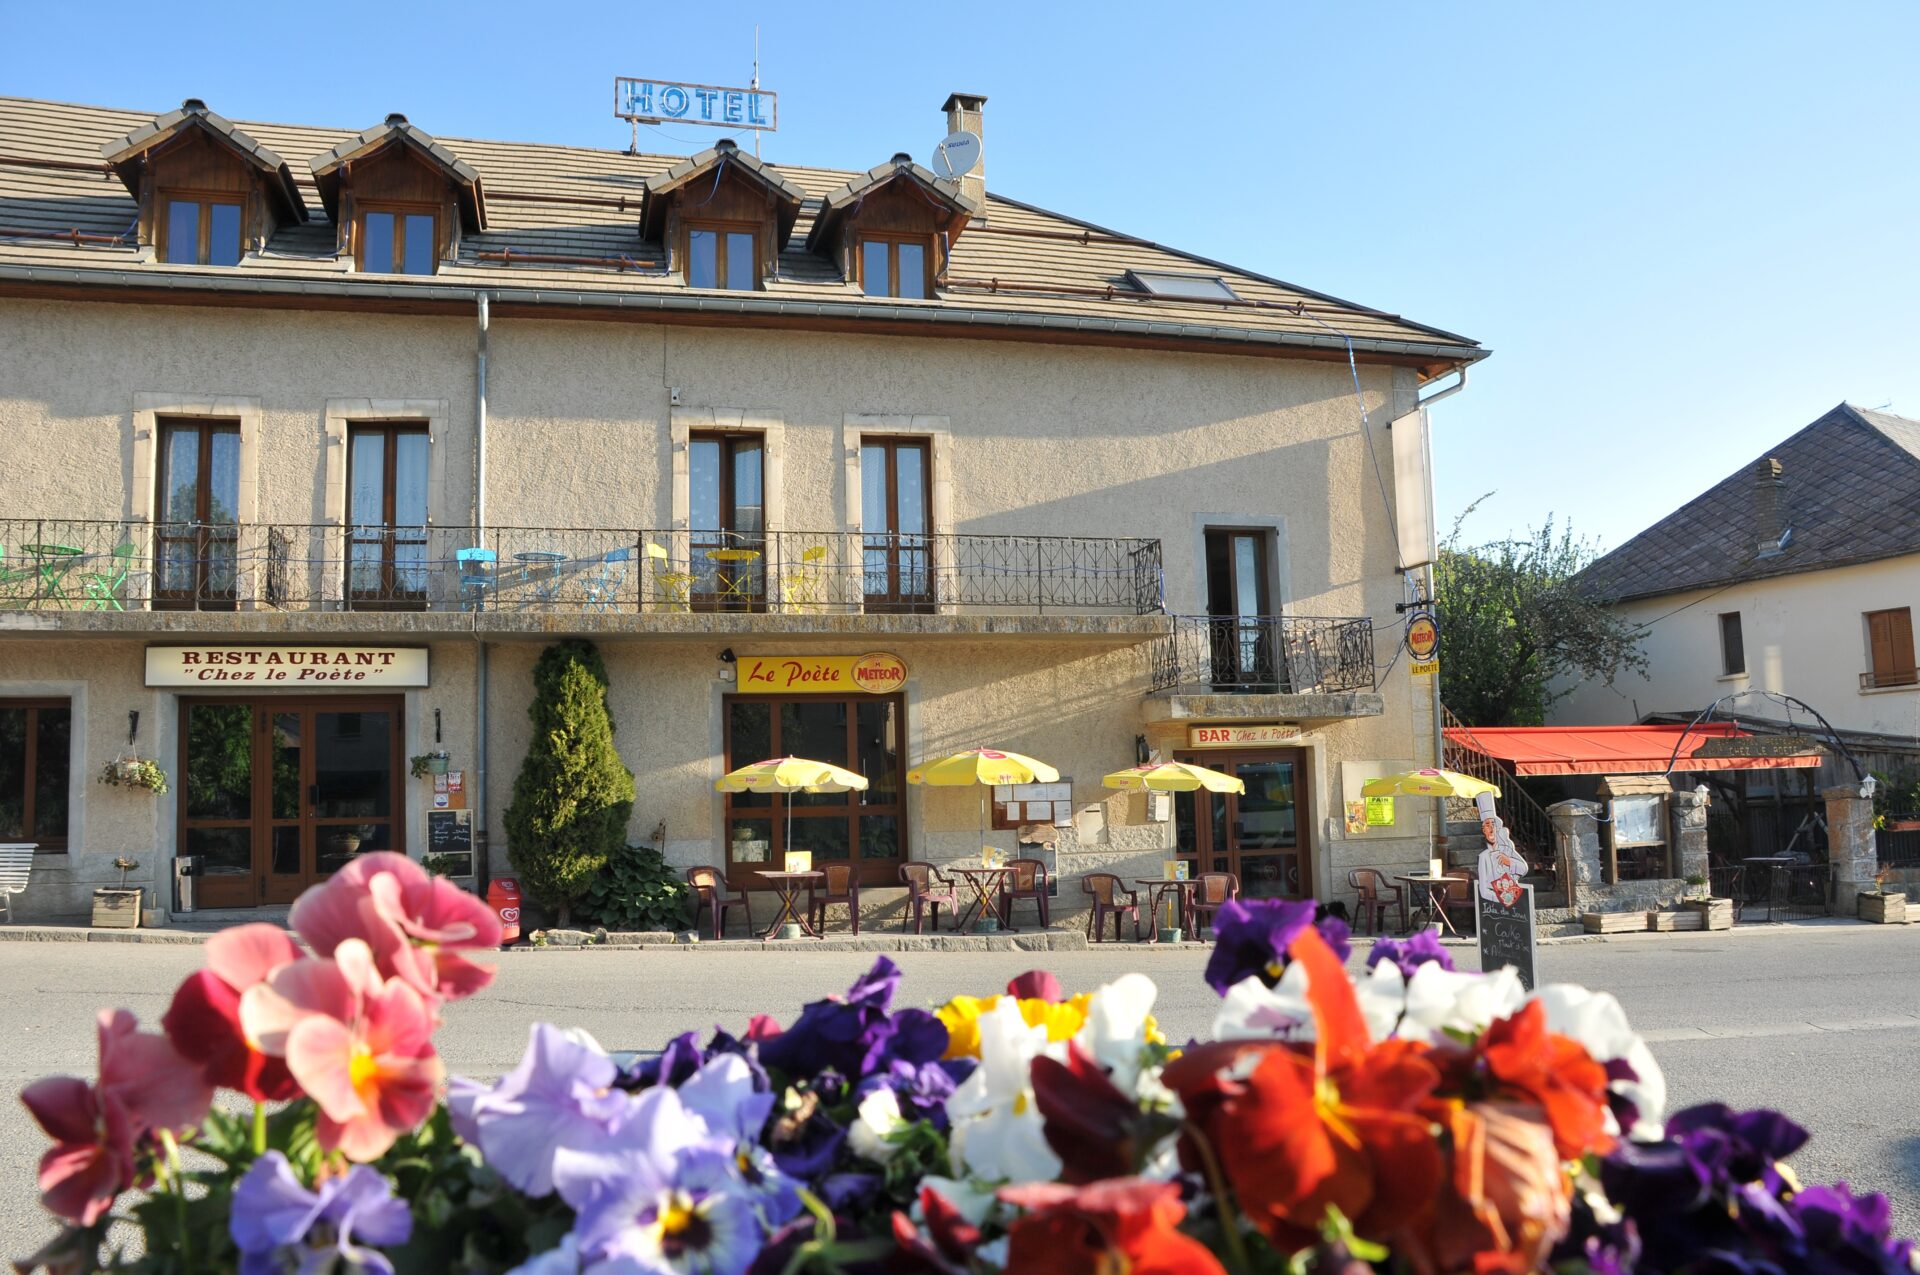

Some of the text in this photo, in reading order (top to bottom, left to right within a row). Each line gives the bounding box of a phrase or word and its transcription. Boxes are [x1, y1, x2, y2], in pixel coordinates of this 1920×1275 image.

[625, 80, 766, 124] HOTEL
[1411, 630, 1434, 645] METEOR
[181, 651, 396, 665] RESTAURANT
[264, 668, 288, 680] le
[748, 660, 841, 688] Le Poète
[857, 667, 901, 680] METEOR
[1412, 665, 1419, 674] LE
[1199, 729, 1231, 742] BAR
[1261, 729, 1268, 740] le
[1729, 747, 1751, 756] CHEZ
[1758, 746, 1768, 755] LE
